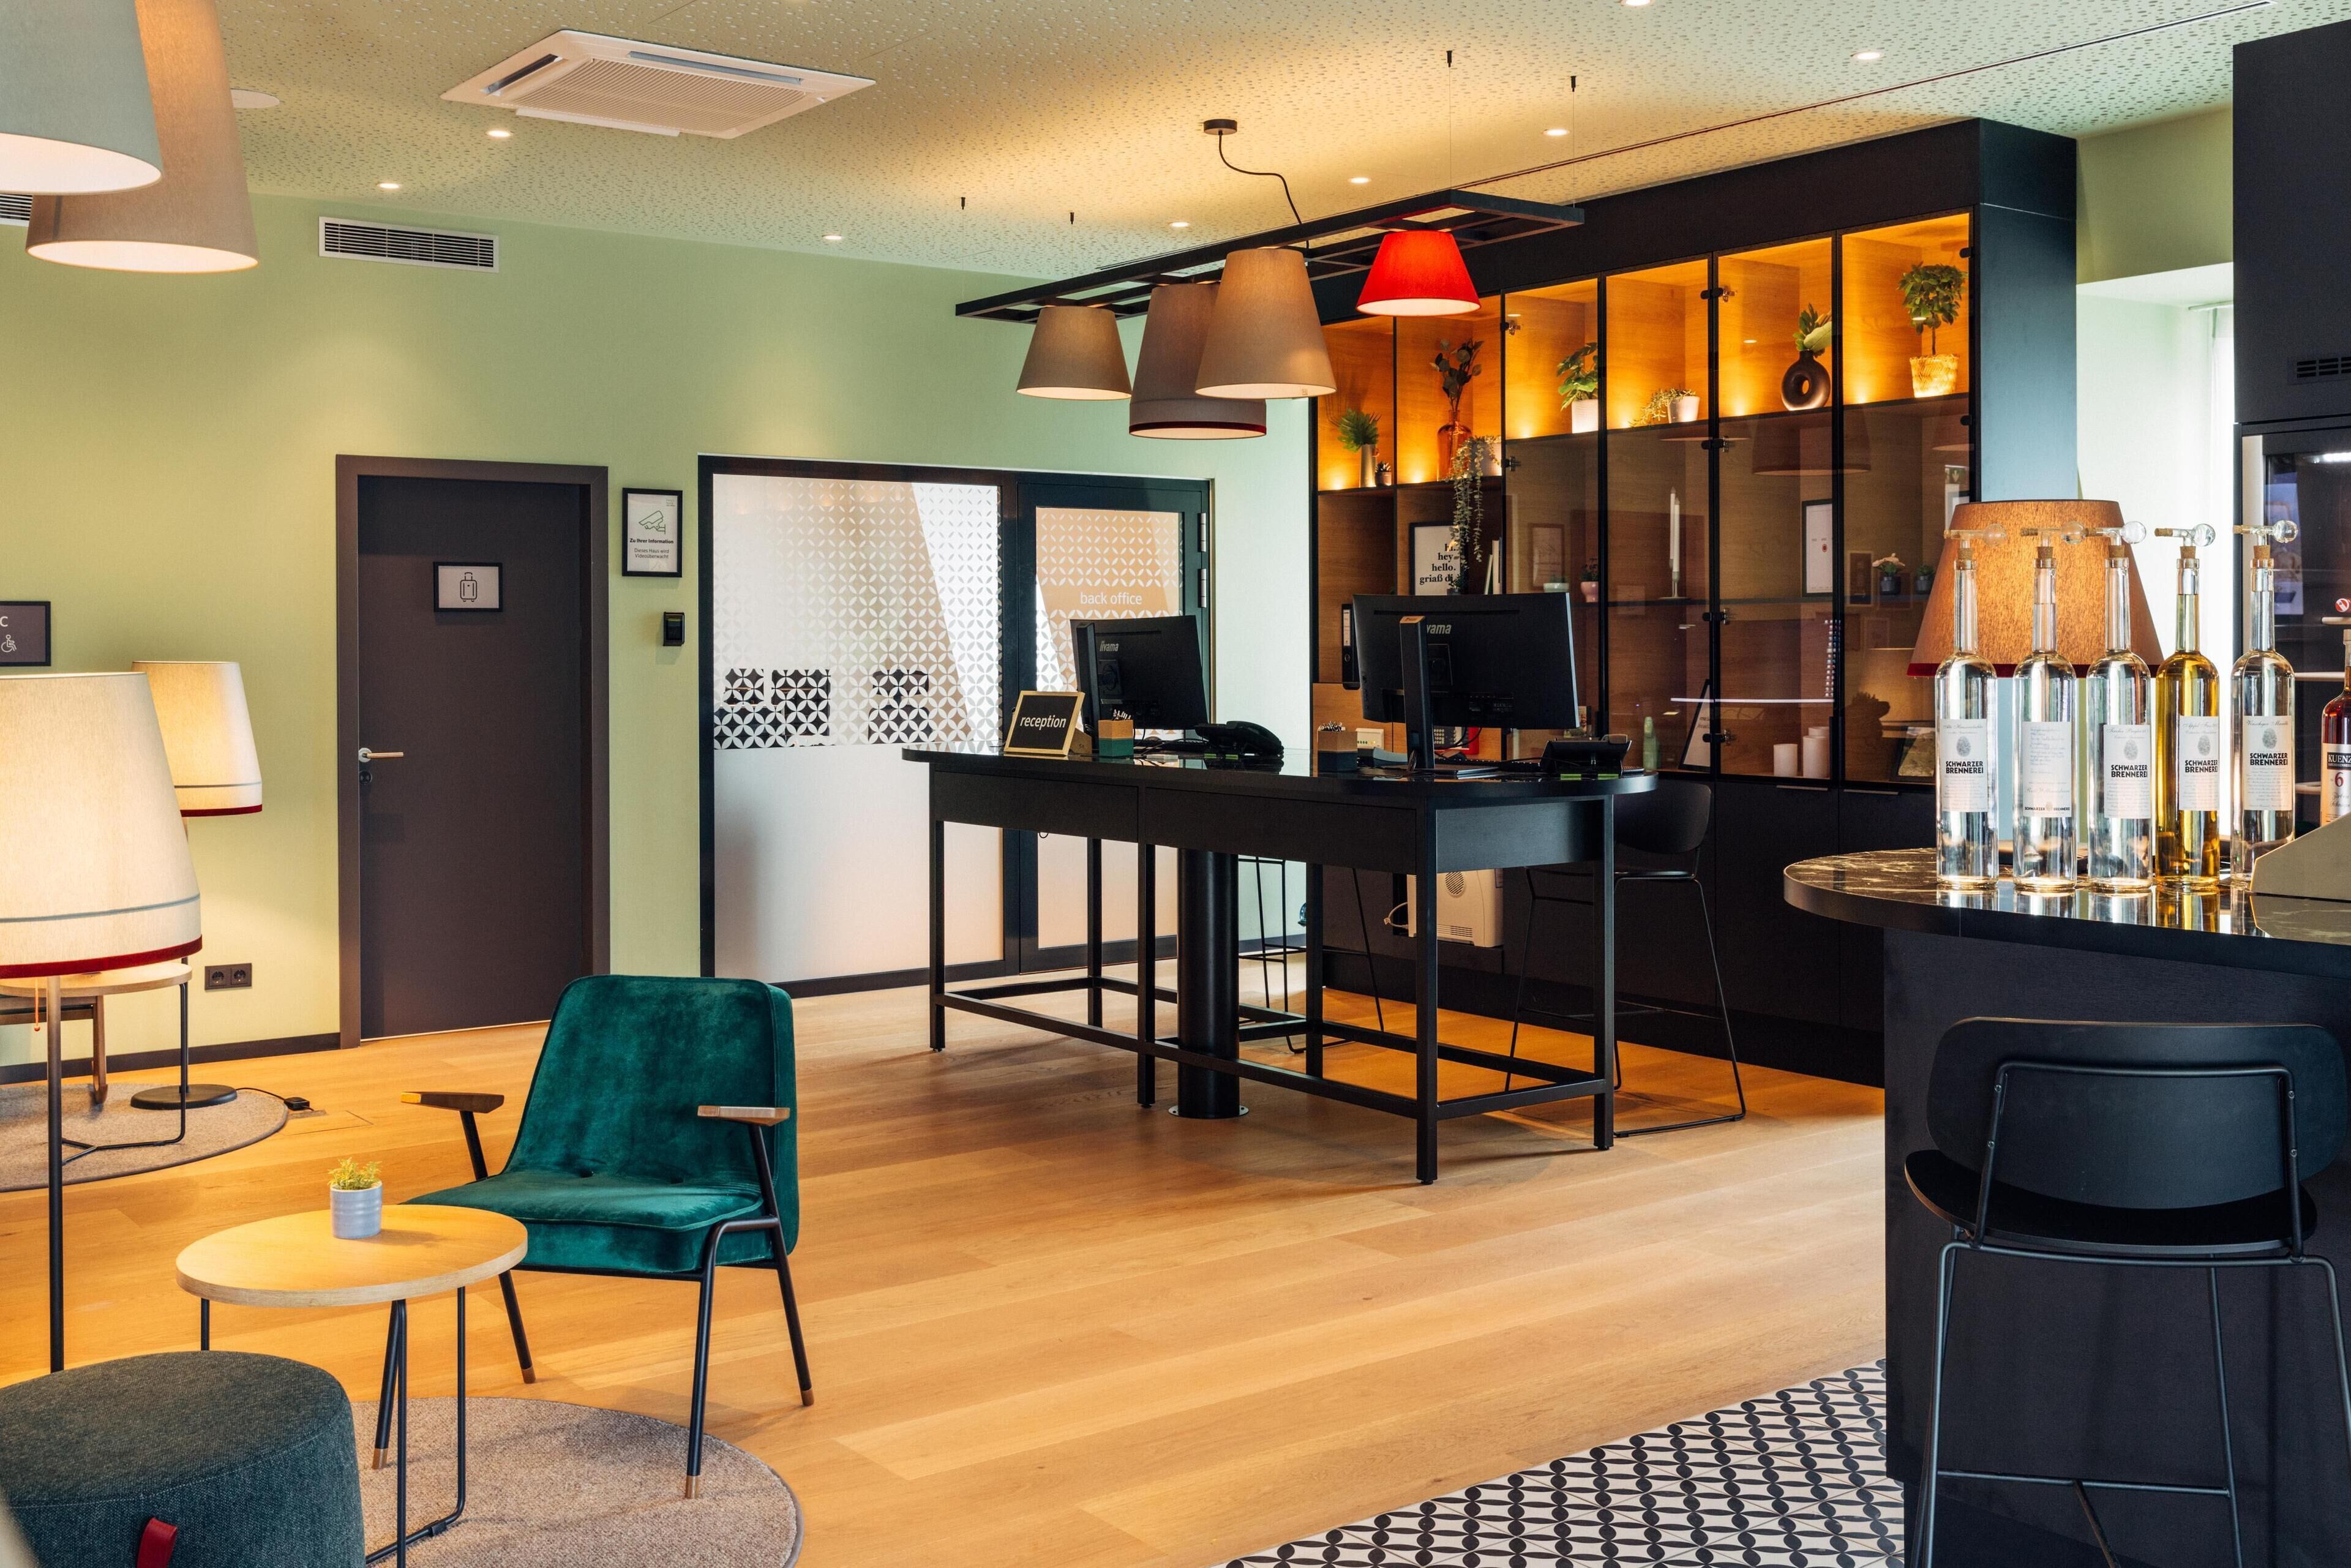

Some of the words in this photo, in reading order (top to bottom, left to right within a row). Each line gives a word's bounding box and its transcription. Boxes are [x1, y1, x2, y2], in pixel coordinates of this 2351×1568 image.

[1419, 574, 1443, 585] griaß
[1080, 591, 1108, 605] back
[1110, 591, 1143, 605] office
[1426, 624, 1452, 634] yama
[1019, 715, 1067, 730] reception
[2334, 771, 2344, 787] 6
